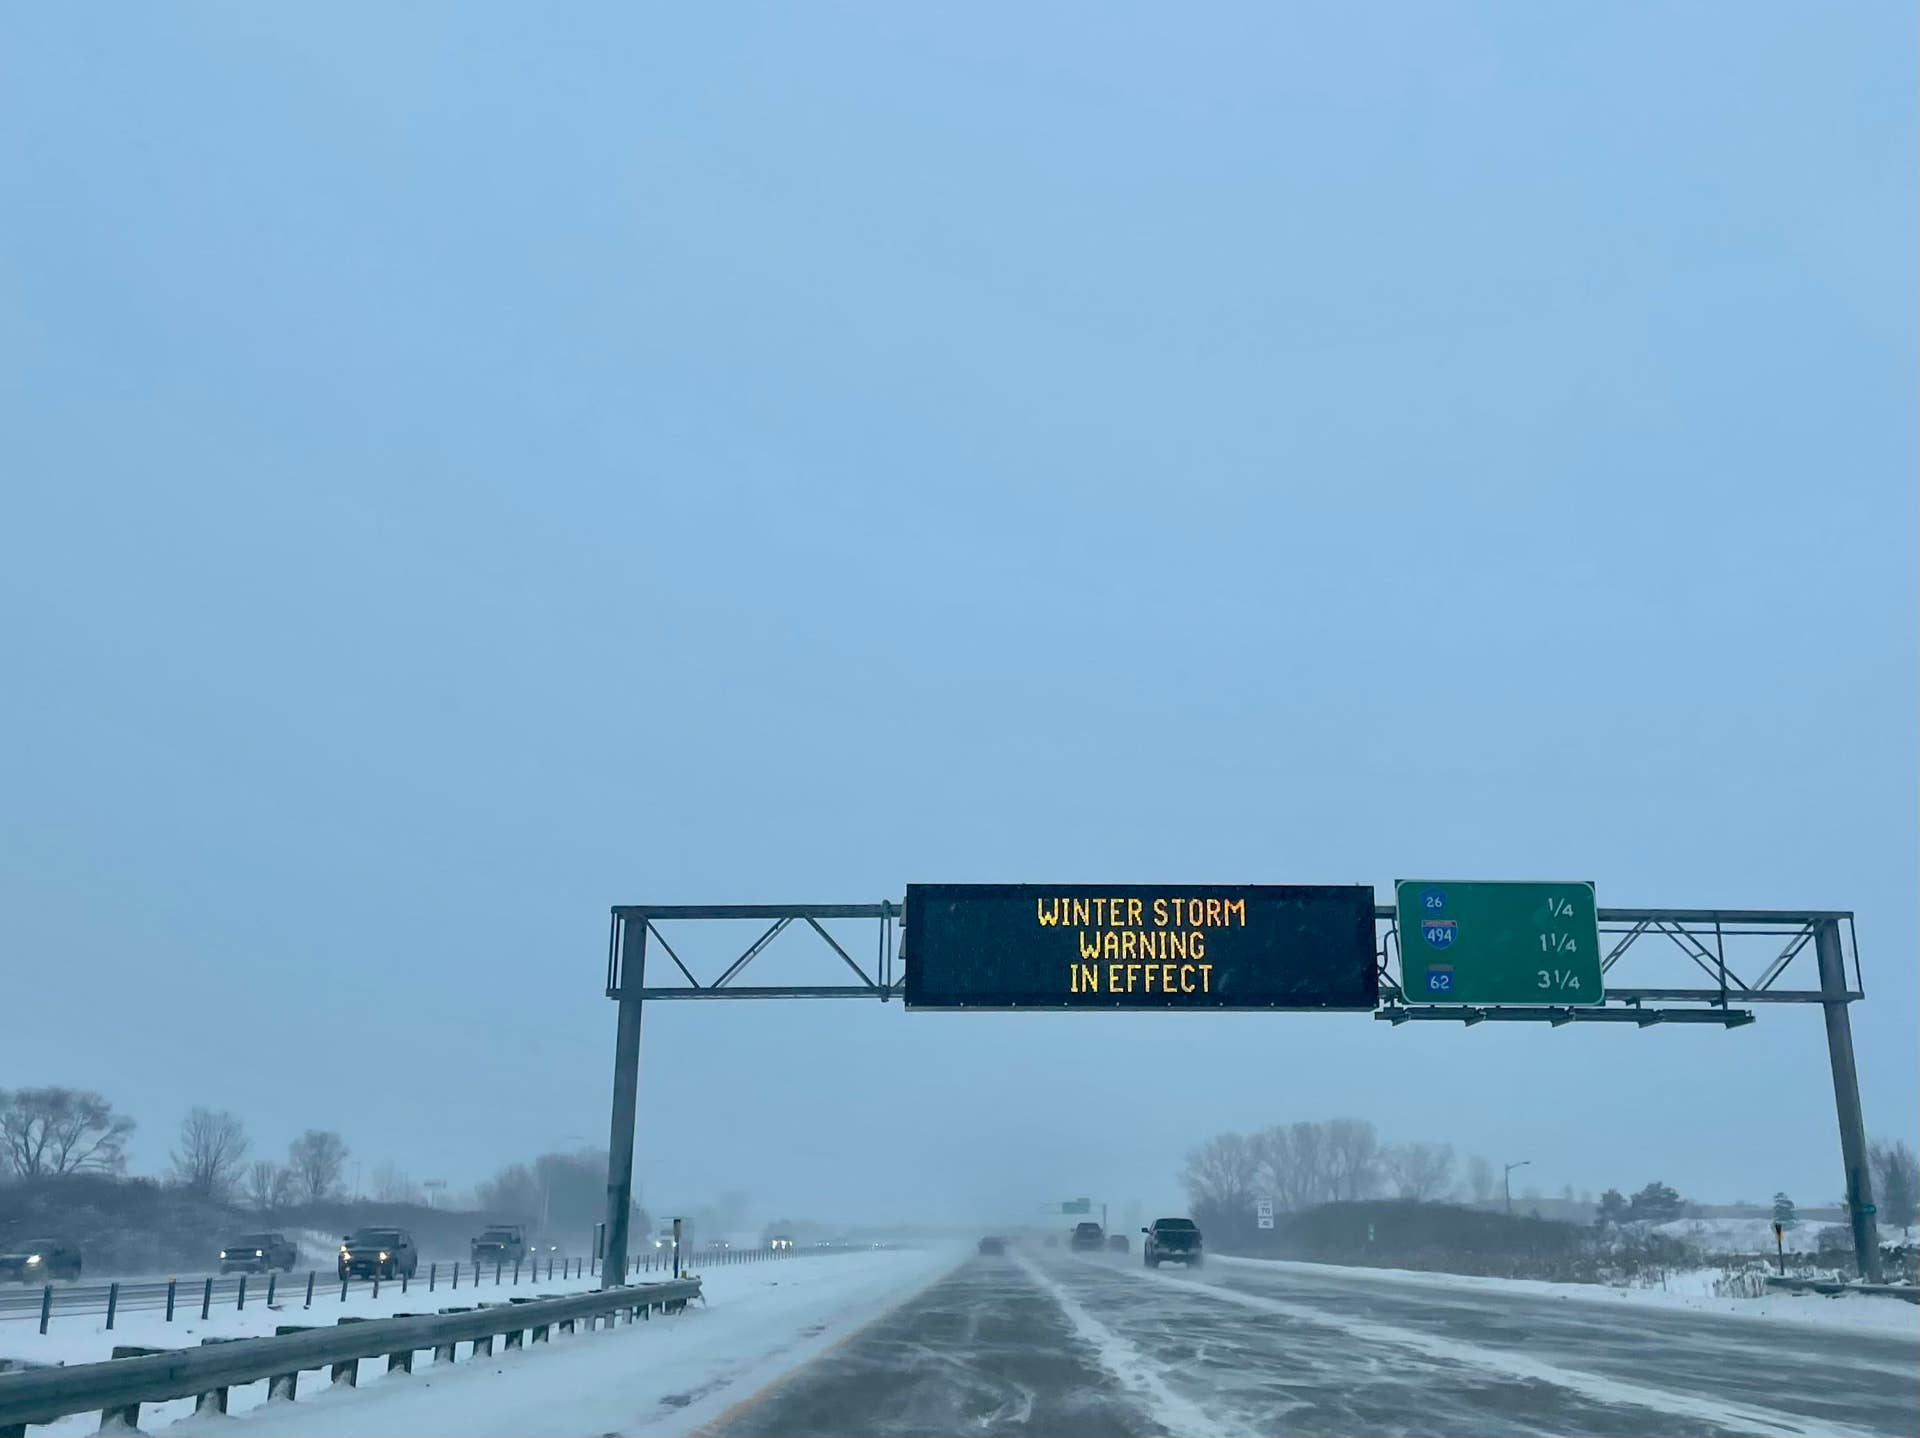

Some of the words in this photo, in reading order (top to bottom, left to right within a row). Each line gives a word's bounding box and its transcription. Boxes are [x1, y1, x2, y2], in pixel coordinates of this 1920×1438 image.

[1037, 898, 1143, 926] WINTER
[1153, 898, 1246, 927] STORM
[1426, 896, 1443, 908] 26
[1079, 931, 1205, 960] WARNING
[1427, 928, 1452, 942] 494
[1070, 964, 1098, 993] IN
[1109, 964, 1213, 993] EFFECT
[1430, 975, 1450, 989] 62
